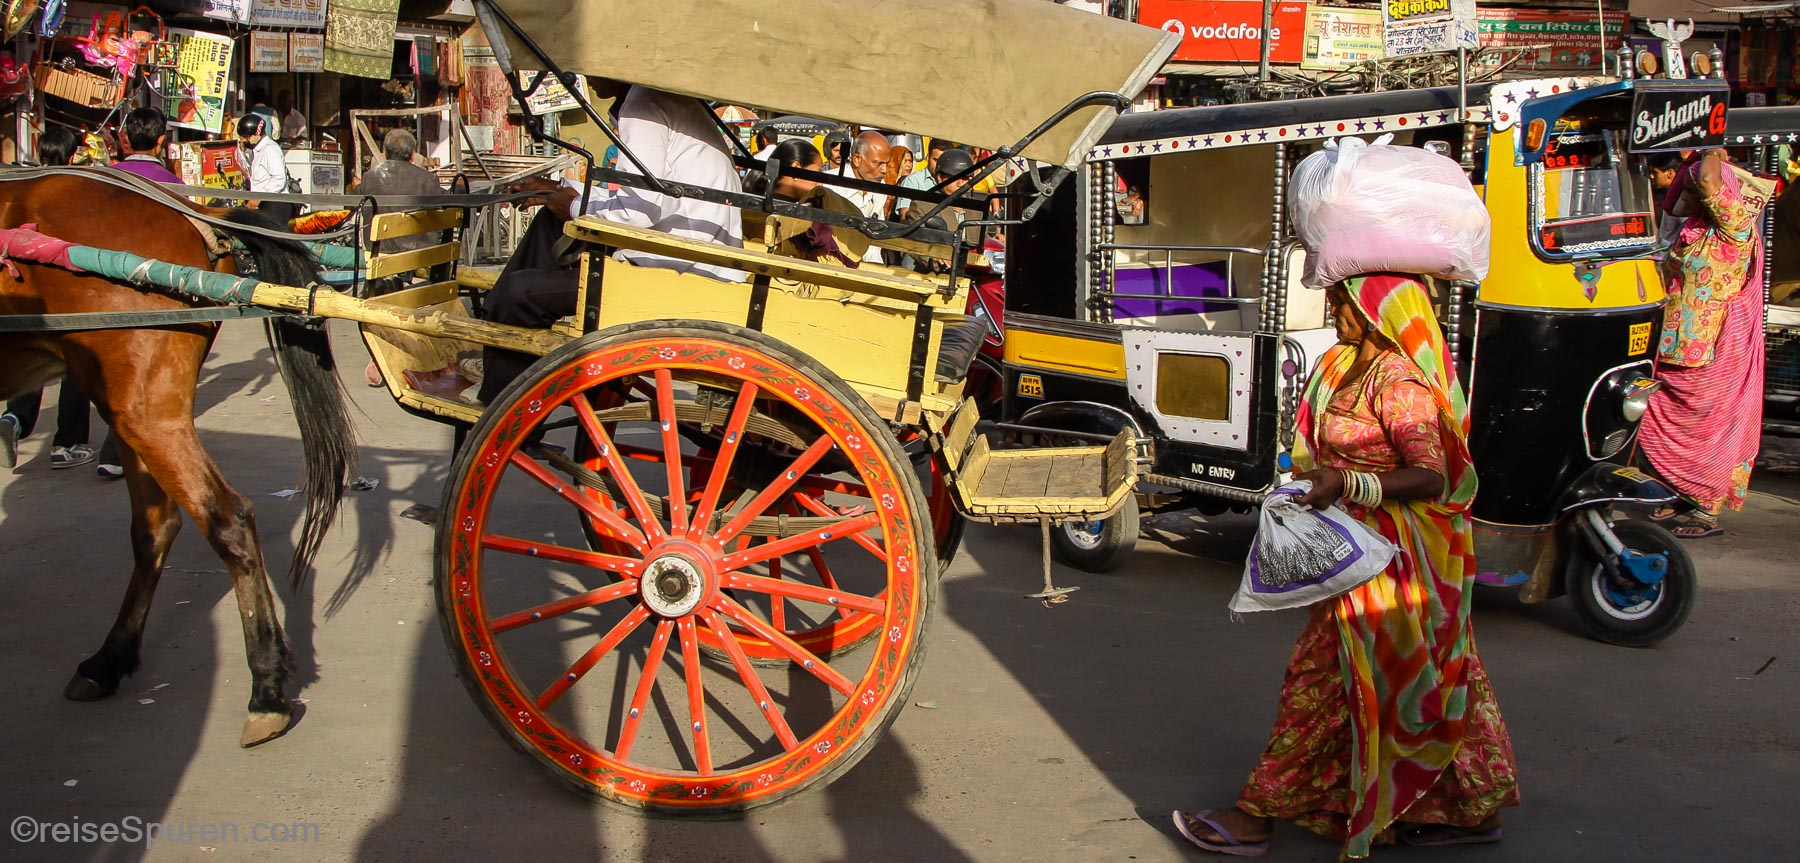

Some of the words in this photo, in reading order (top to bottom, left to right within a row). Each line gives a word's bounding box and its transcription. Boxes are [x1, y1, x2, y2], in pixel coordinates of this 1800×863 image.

[1389, 1, 1410, 19] दूध
[1410, 0, 1425, 14] का
[1192, 22, 1280, 40] vodafoe
[1314, 20, 1328, 36] न्यू
[1333, 16, 1371, 35] नेशनल
[1479, 23, 1493, 32] यू
[1546, 22, 1590, 31] रिपेयर
[1396, 38, 1404, 46] 23
[218, 44, 230, 66] Aloe
[214, 70, 226, 94] Vera
[1634, 94, 1712, 144] Suhana
[1709, 102, 1726, 134] G
[1631, 336, 1648, 352] 1515
[1021, 385, 1041, 395] 1515
[1192, 463, 1204, 474] NO
[1209, 466, 1235, 480] ENTRY
